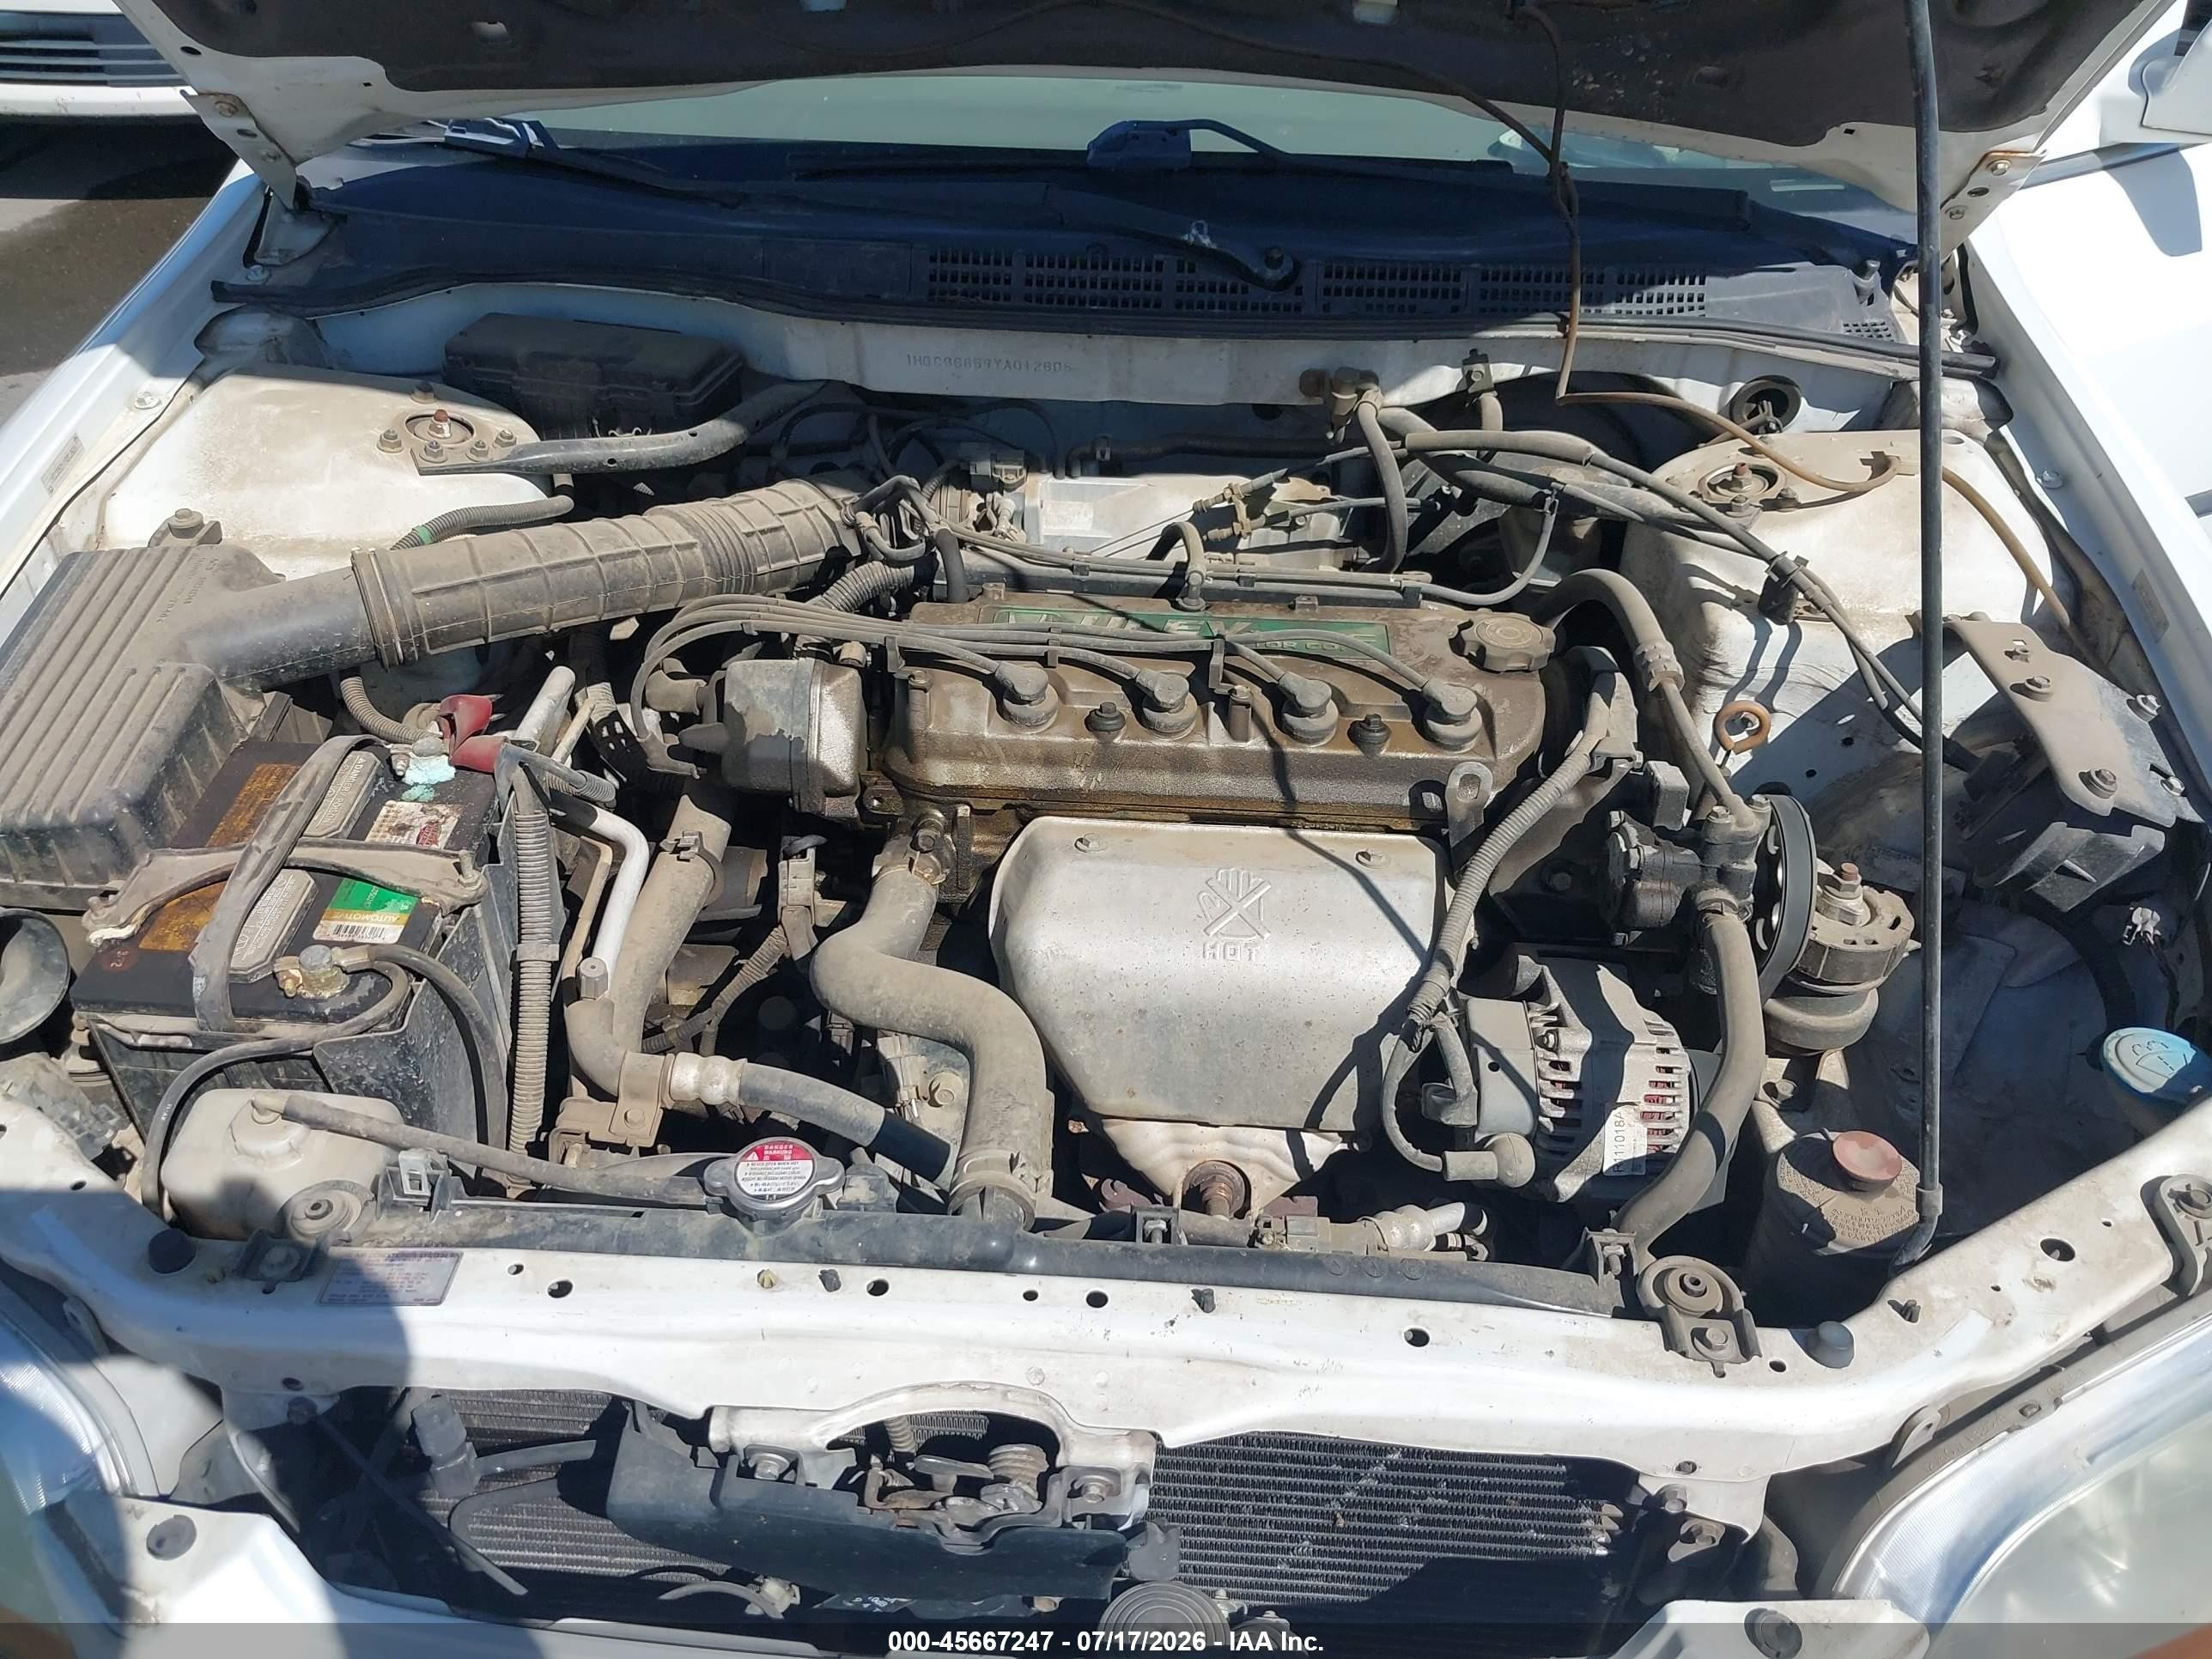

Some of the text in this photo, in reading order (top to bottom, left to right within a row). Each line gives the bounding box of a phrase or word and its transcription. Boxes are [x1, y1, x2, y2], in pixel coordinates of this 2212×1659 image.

[332, 911, 398, 922] AUTOMOTIVE
[1202, 940, 1259, 962] HOT
[1613, 1111, 1626, 1173] R111018A
